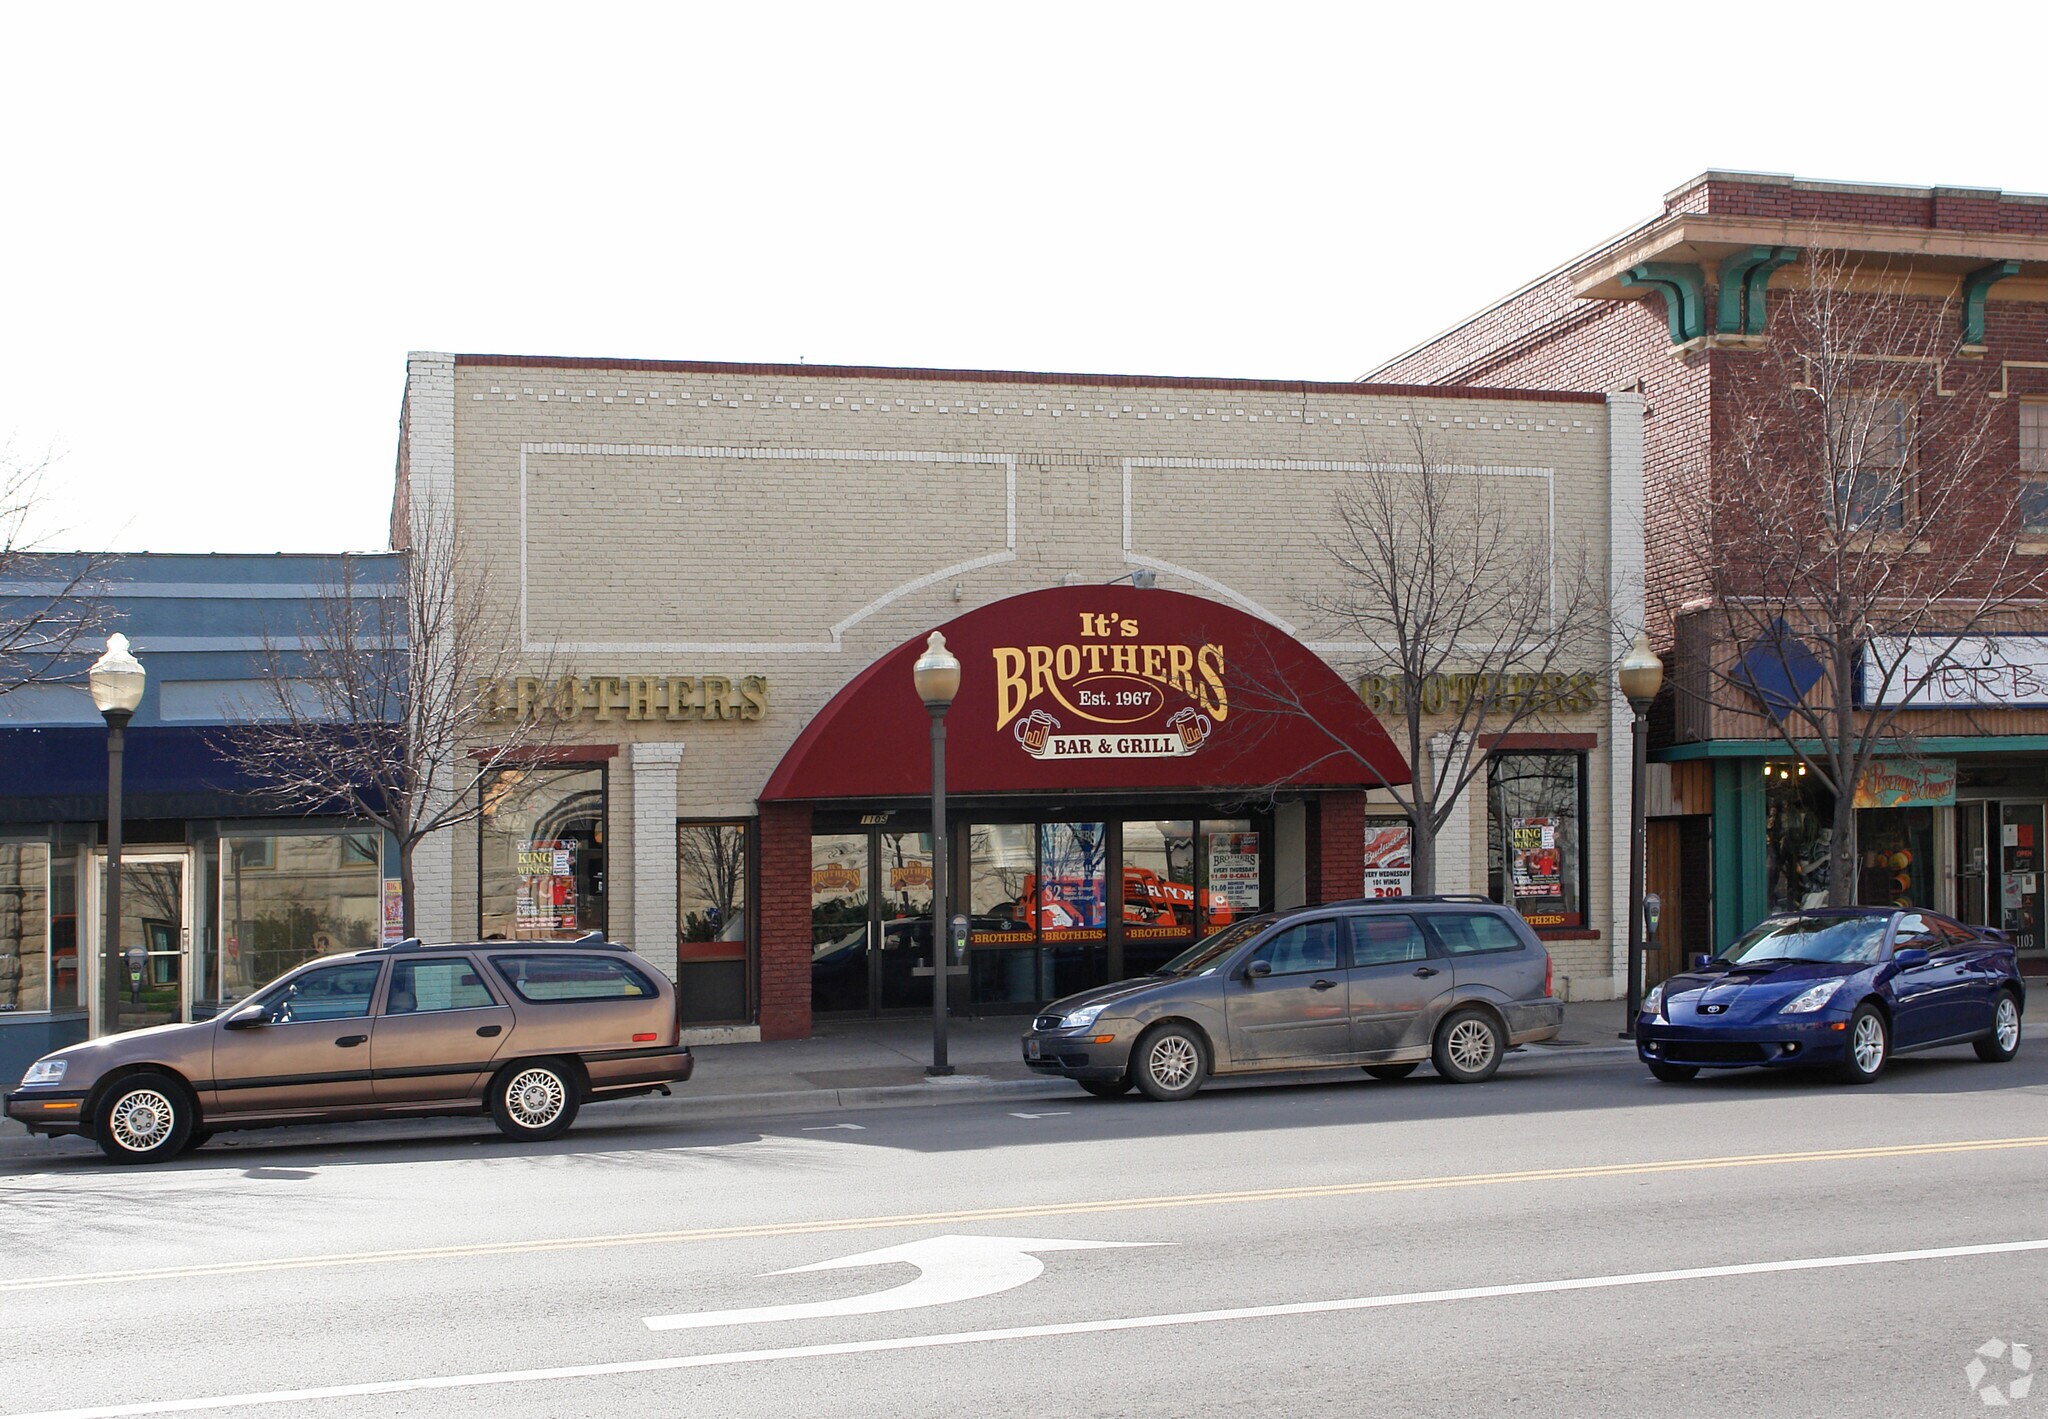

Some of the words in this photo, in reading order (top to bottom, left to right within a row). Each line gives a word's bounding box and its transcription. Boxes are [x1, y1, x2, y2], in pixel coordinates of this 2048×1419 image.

[1079, 612, 1139, 637] It's
[992, 643, 1228, 732] BROTHERS
[1079, 691, 1111, 706] Est.
[1116, 691, 1151, 706] 1967
[1054, 740, 1093, 755] BAR
[1098, 739, 1113, 754] &
[1116, 738, 1175, 754] GRILL
[1514, 828, 1541, 839] KING
[517, 852, 553, 864] KING
[1213, 855, 1256, 867] BROTHERS
[812, 869, 860, 888] BROTHERS
[891, 867, 933, 887] BROTHER
[1379, 870, 1410, 878] WEDNESDAY
[1523, 915, 1562, 925] OTHERS
[974, 932, 1033, 943] BROTHERS
[1045, 930, 1103, 941] BROTHERS
[1130, 927, 1187, 938] BROTHERS
[2016, 934, 2034, 947] 1103
